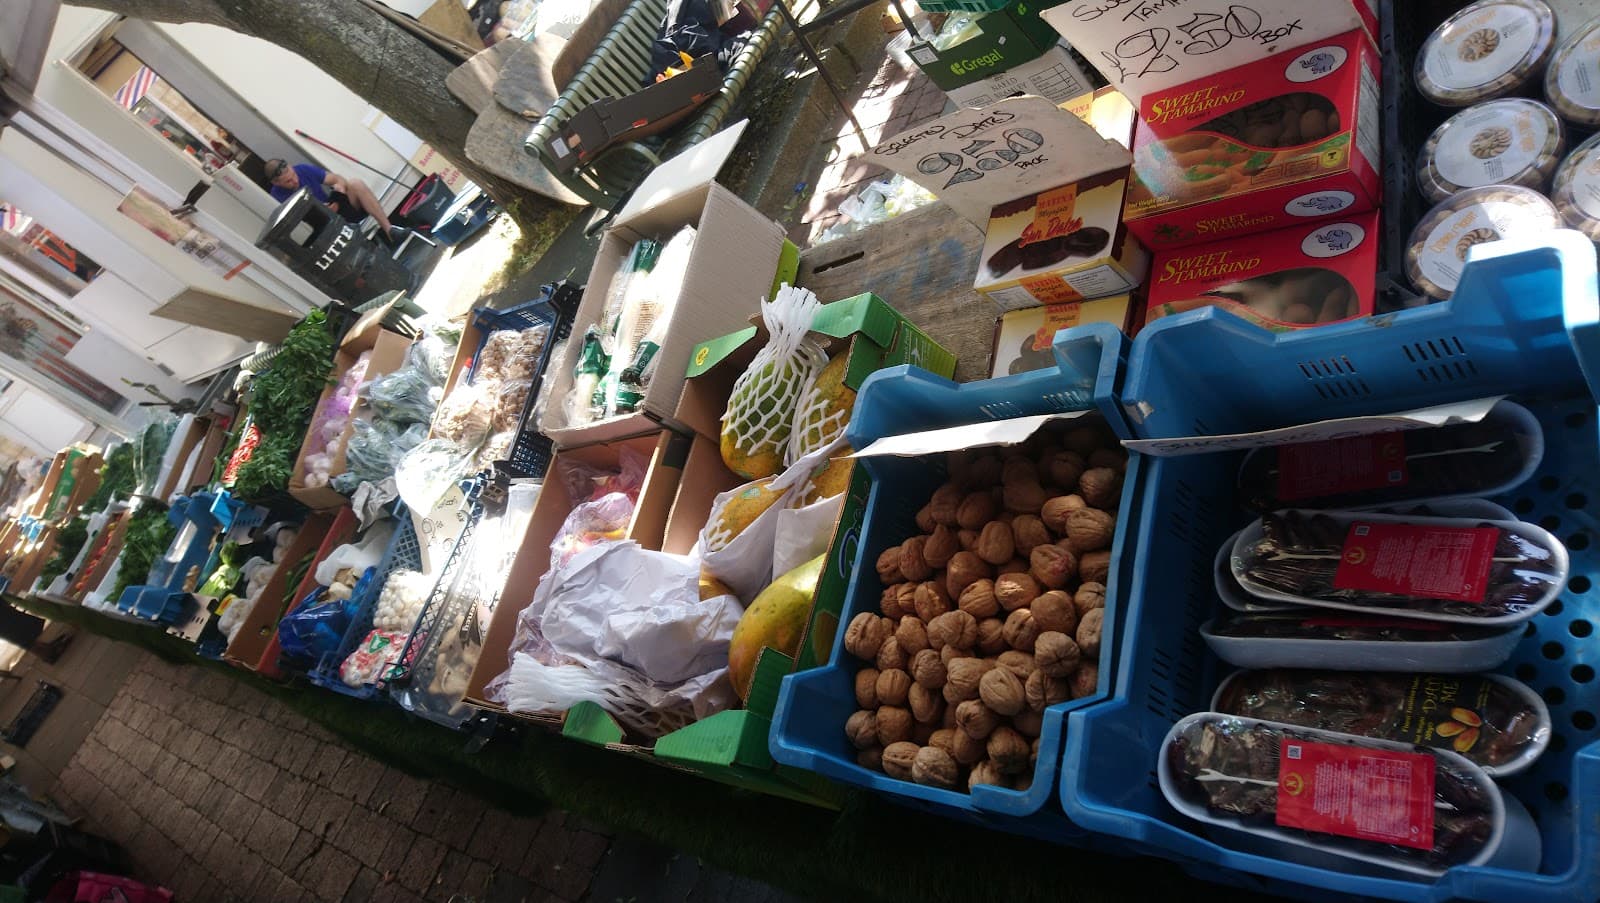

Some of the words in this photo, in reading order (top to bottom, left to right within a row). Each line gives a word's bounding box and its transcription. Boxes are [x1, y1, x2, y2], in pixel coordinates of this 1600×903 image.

[1251, 18, 1304, 45] BOX
[962, 49, 1004, 73] Gregal
[1146, 85, 1220, 124] SWEET
[1161, 90, 1245, 125] TAMARIND
[1014, 154, 1048, 171] PACK
[1195, 213, 1248, 234] SWEET
[1212, 215, 1274, 234] TAMARIND
[1158, 251, 1232, 283] SWEET
[1175, 258, 1261, 285] TAMARIND
